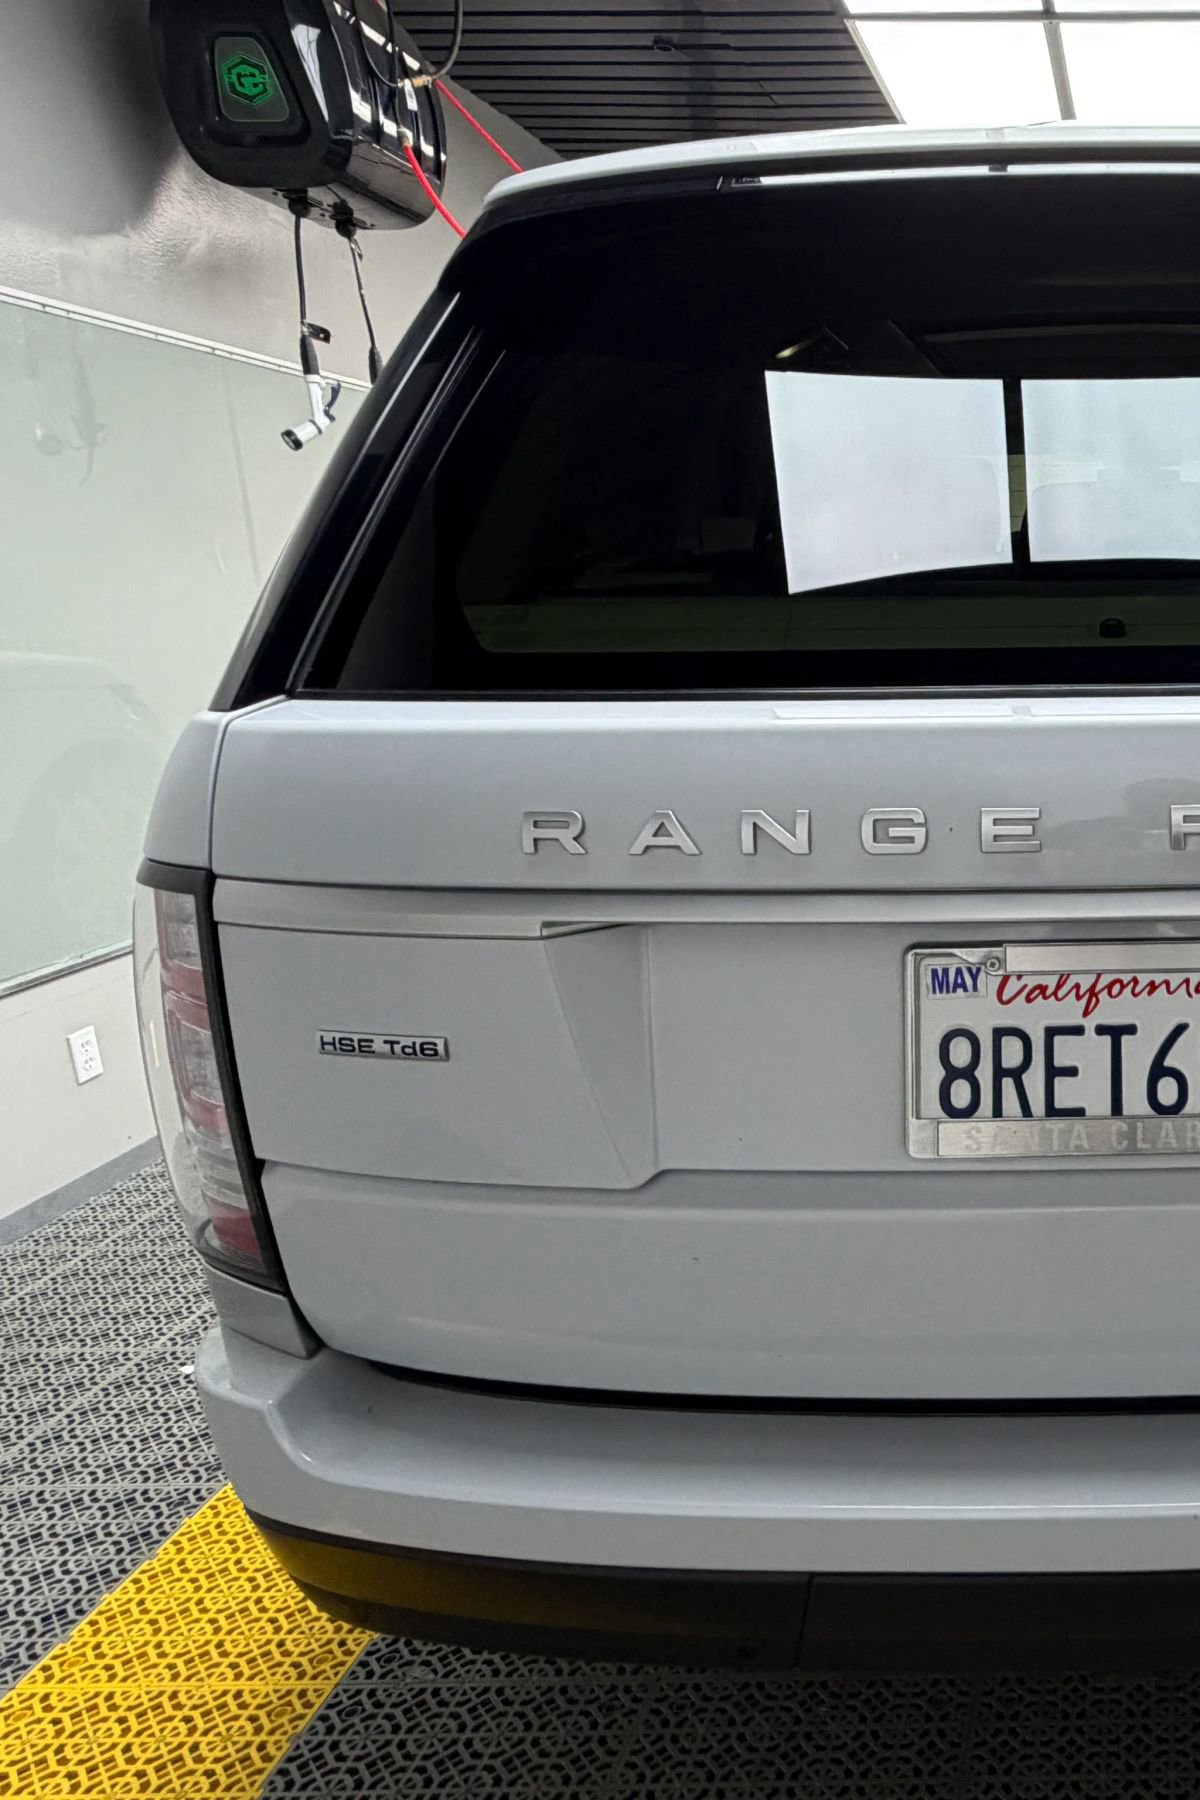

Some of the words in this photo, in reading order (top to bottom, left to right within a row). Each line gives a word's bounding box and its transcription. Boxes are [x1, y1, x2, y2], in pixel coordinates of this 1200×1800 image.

[521, 807, 1043, 856] RANGE
[931, 966, 982, 995] MAY
[319, 1035, 376, 1054] HSE
[383, 1039, 439, 1058] Td6
[963, 1121, 1090, 1152] SNTA
